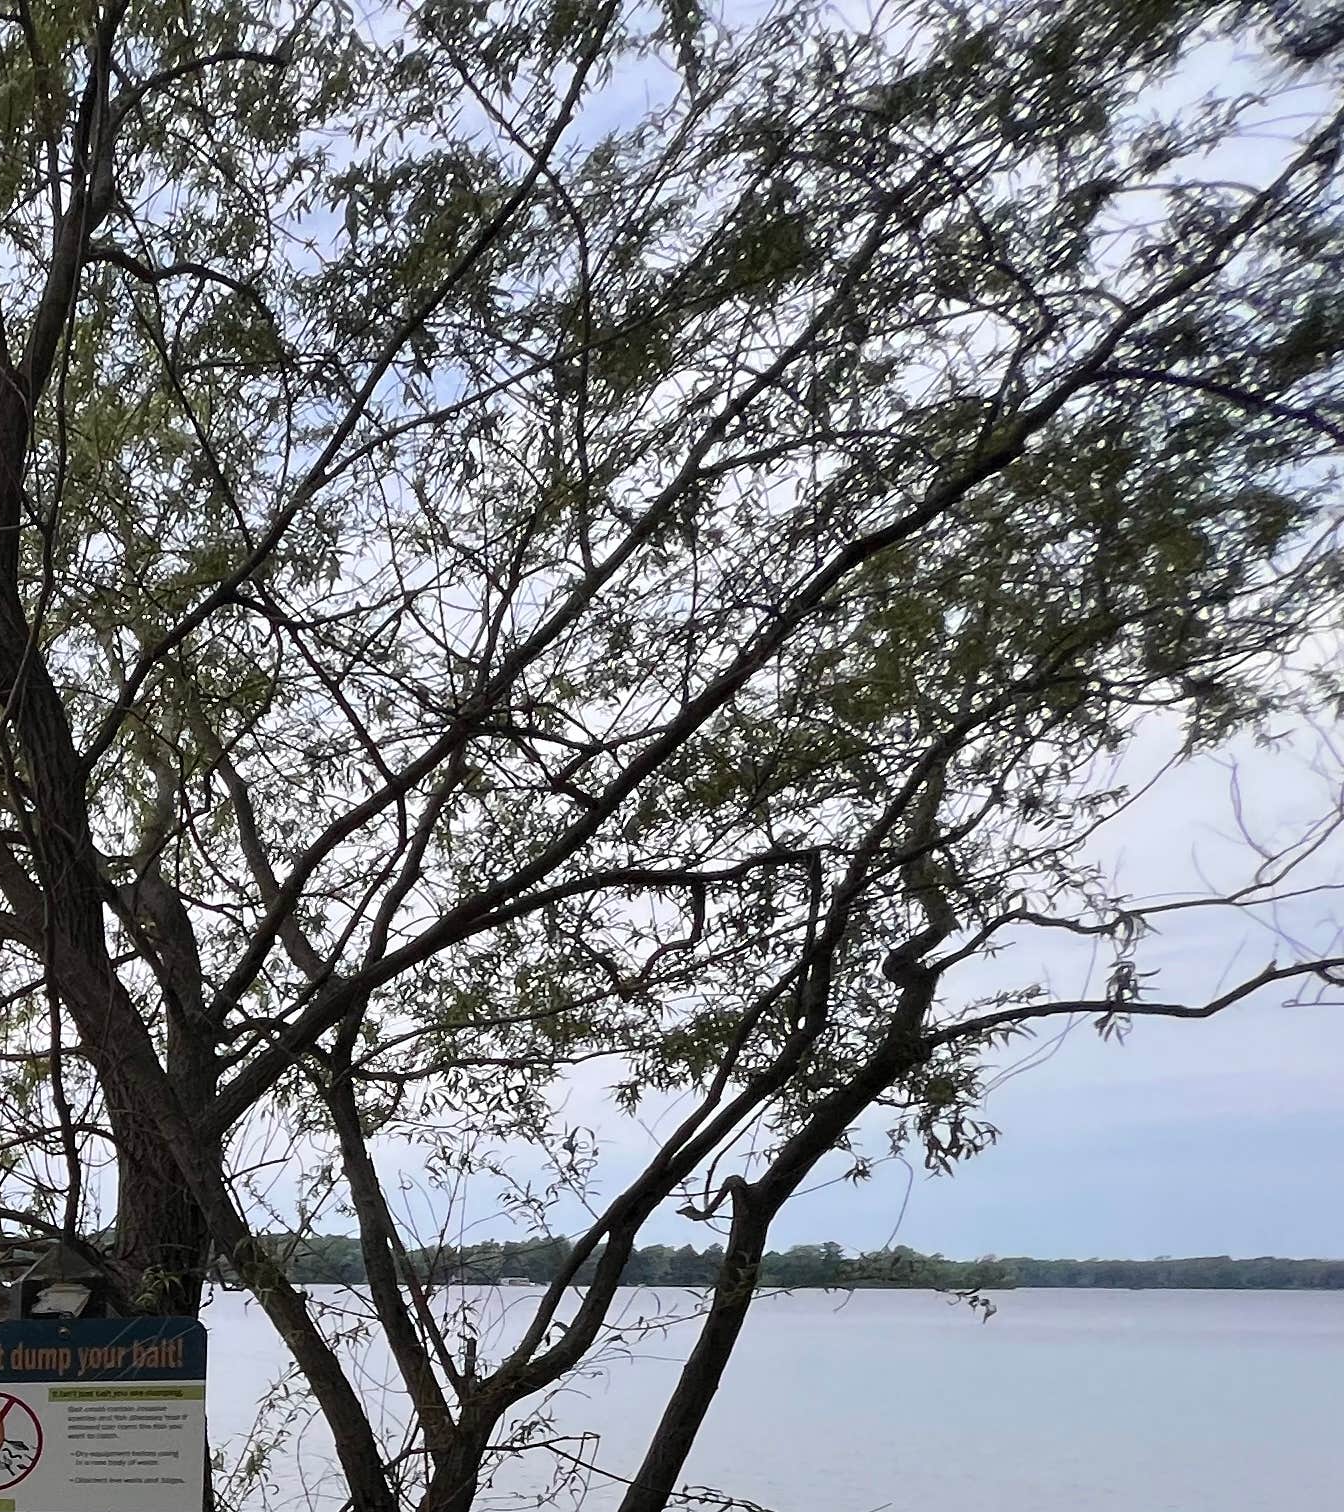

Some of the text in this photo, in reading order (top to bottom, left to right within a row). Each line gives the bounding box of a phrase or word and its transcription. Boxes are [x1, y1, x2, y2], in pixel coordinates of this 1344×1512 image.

[11, 1342, 72, 1376] dump
[77, 1346, 126, 1376] your
[132, 1338, 184, 1369] bait!
